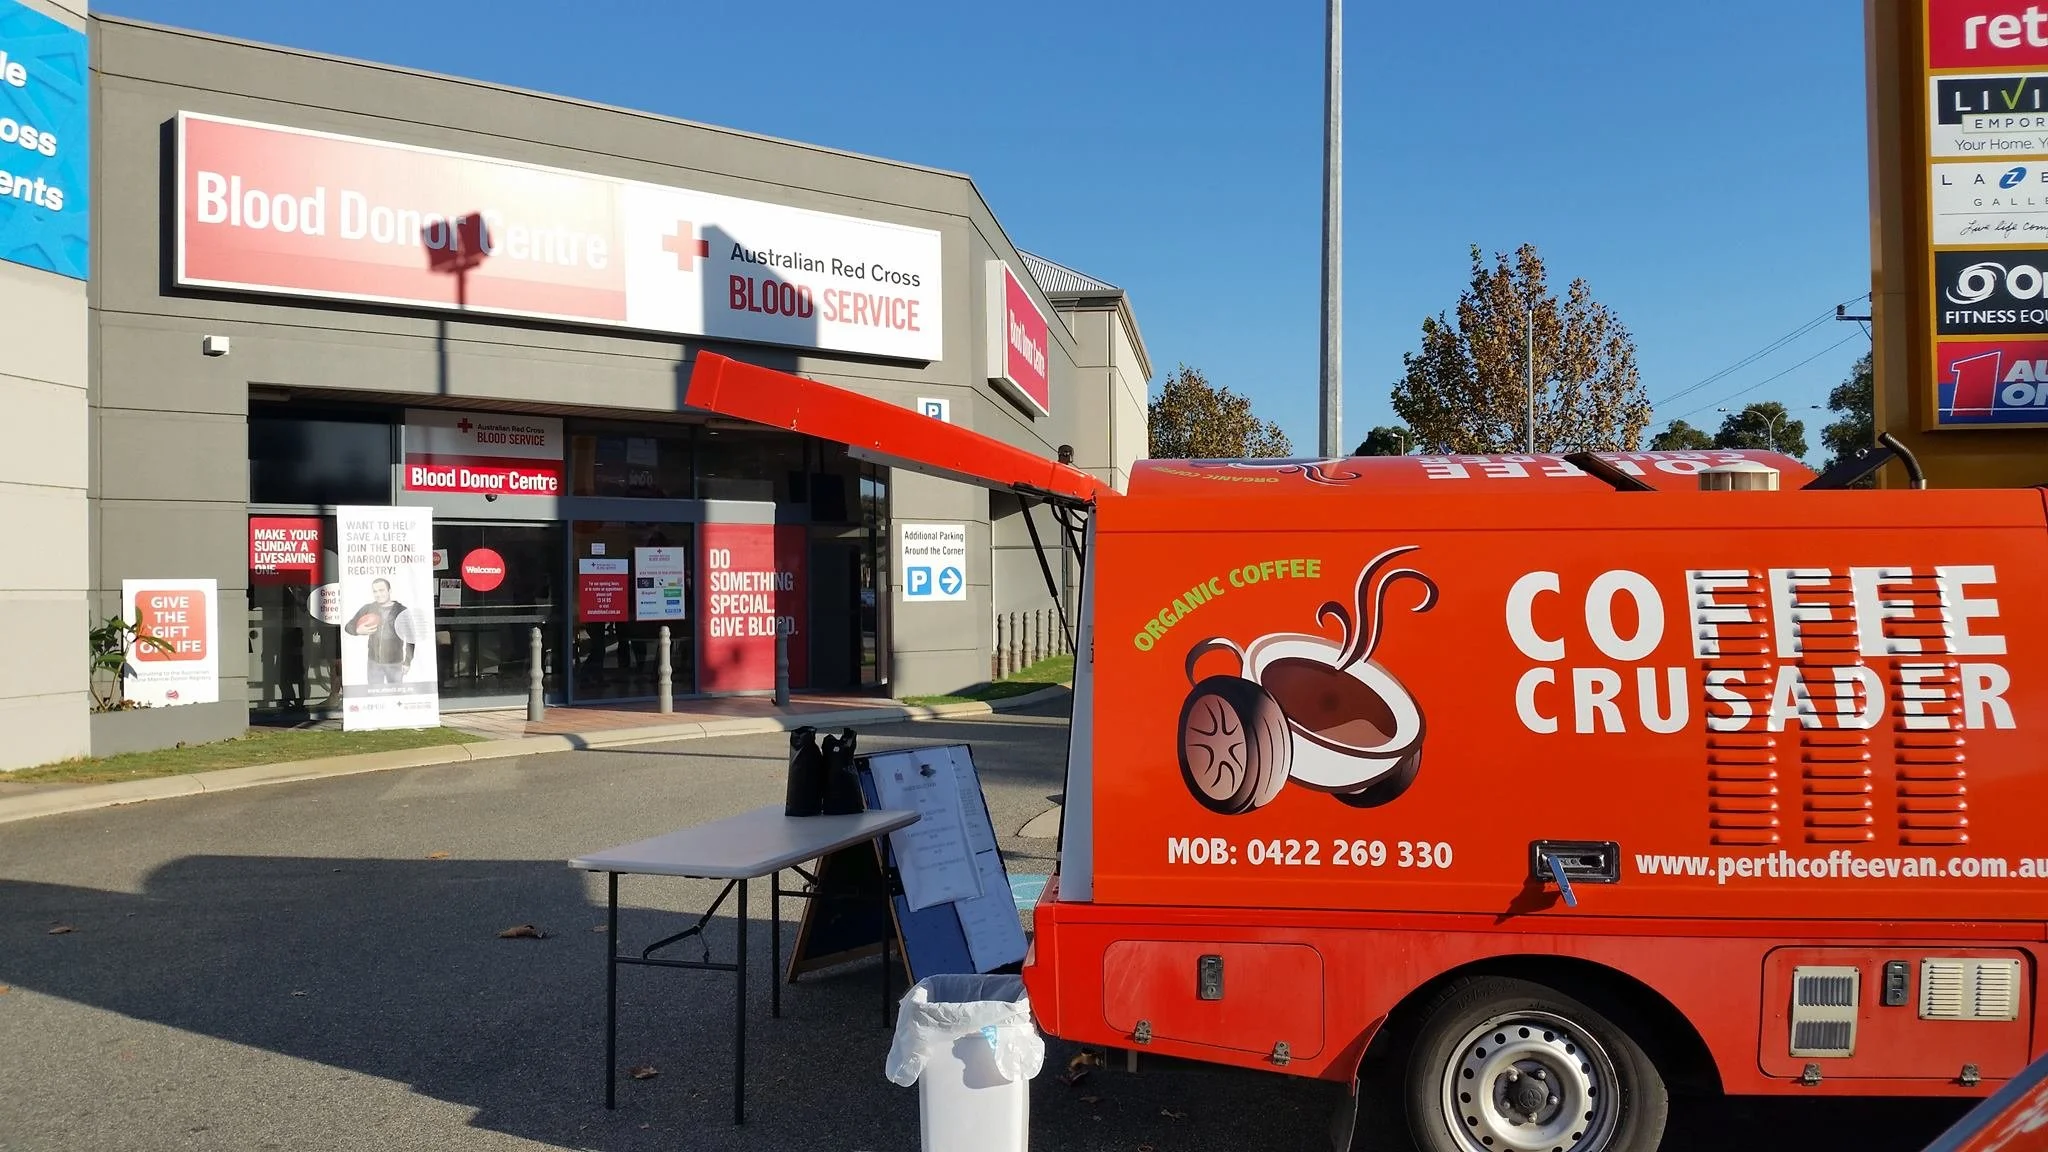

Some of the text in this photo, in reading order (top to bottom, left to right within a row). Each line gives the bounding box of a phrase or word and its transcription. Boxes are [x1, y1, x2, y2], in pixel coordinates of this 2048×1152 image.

[1965, 6, 2048, 49] ret
[1955, 77, 2040, 111] LIVI
[1974, 117, 2045, 129] EMPOR
[0, 117, 57, 157] oss
[1955, 139, 1986, 151] Your
[1990, 138, 2034, 150] Home.
[0, 169, 64, 212] ents
[197, 171, 608, 270] Blood Donor Centre
[730, 242, 921, 287] Australian Red Cross
[729, 274, 921, 332] BLOOD SERVICE
[1945, 310, 2017, 324] FITNESS
[477, 424, 510, 432] Australian
[512, 425, 525, 433] Red
[477, 432, 545, 446] BLOOD SERVICE
[412, 467, 558, 491] Blood Donor Centre
[1202, 474, 1280, 483] ORGANIC
[346, 521, 416, 530] WANT TO HELP
[254, 529, 318, 540] MAKE YOUR
[346, 532, 407, 541] SAVE A LIFE?
[904, 531, 964, 542] Additional Parking
[254, 540, 309, 552] SUNDAY A
[347, 544, 416, 552] JOIN THE BONE
[904, 546, 964, 555] Around the Corner
[254, 552, 316, 564] LIVESAVING
[347, 555, 391, 564] MARROW
[394, 555, 426, 564] DONOR
[709, 548, 731, 569] DO
[254, 563, 279, 575] ONE.
[347, 566, 396, 575] REGISTRY!
[465, 566, 501, 574] Welcome
[710, 571, 794, 592] SOMETHING
[151, 596, 190, 609] GIVE
[710, 594, 775, 614] SPECIAL.
[1134, 559, 1321, 651] ORGANIC COFFEE
[153, 611, 187, 623] THE
[1505, 564, 2007, 661] COFFEE
[151, 625, 190, 638] GIFT
[710, 616, 744, 637] GIVE
[167, 640, 202, 653] IFE
[1515, 663, 2016, 734] CRUSADER
[1168, 837, 1453, 869] MOB: 0422 269 330
[1635, 849, 2048, 884] www.perthcoffeevan.com.au
